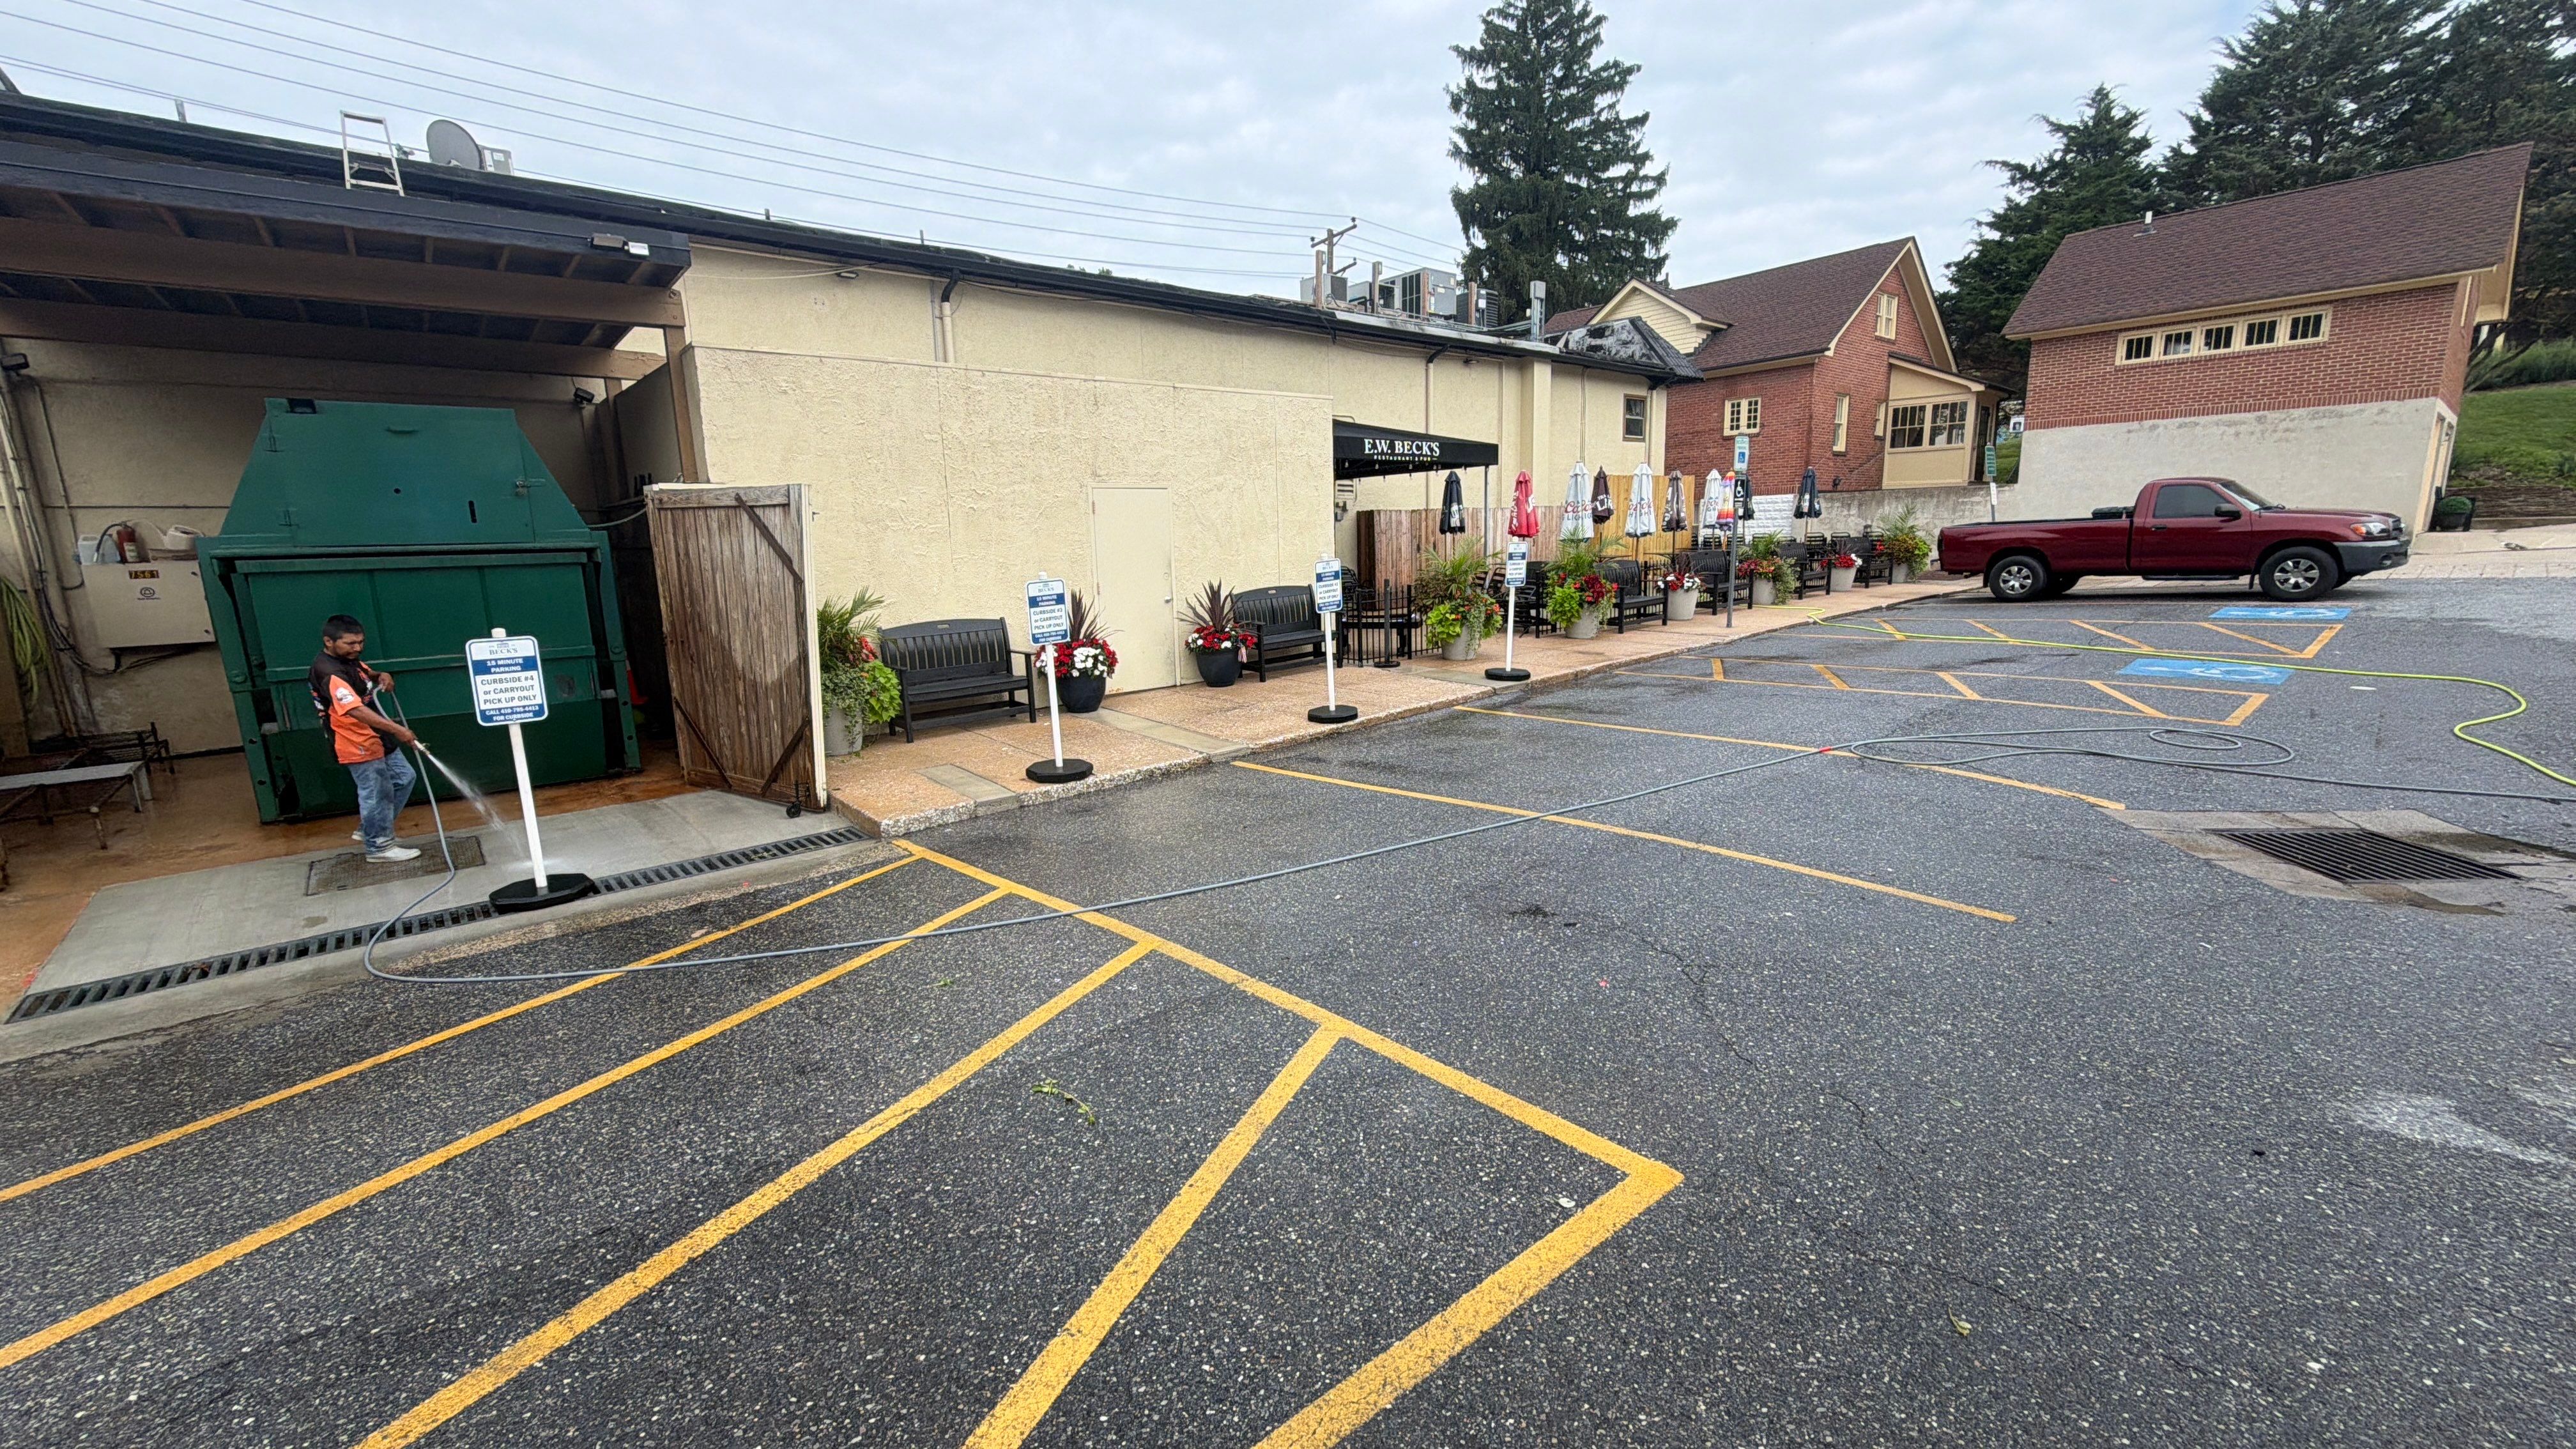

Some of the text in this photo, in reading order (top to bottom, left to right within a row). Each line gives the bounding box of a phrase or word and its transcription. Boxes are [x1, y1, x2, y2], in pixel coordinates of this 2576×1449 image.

[1364, 438, 1439, 456] E.W. BECK'S
[491, 665, 521, 673] PARKING
[480, 676, 523, 686] CURBSIDE
[493, 685, 535, 694] CARRYOUT
